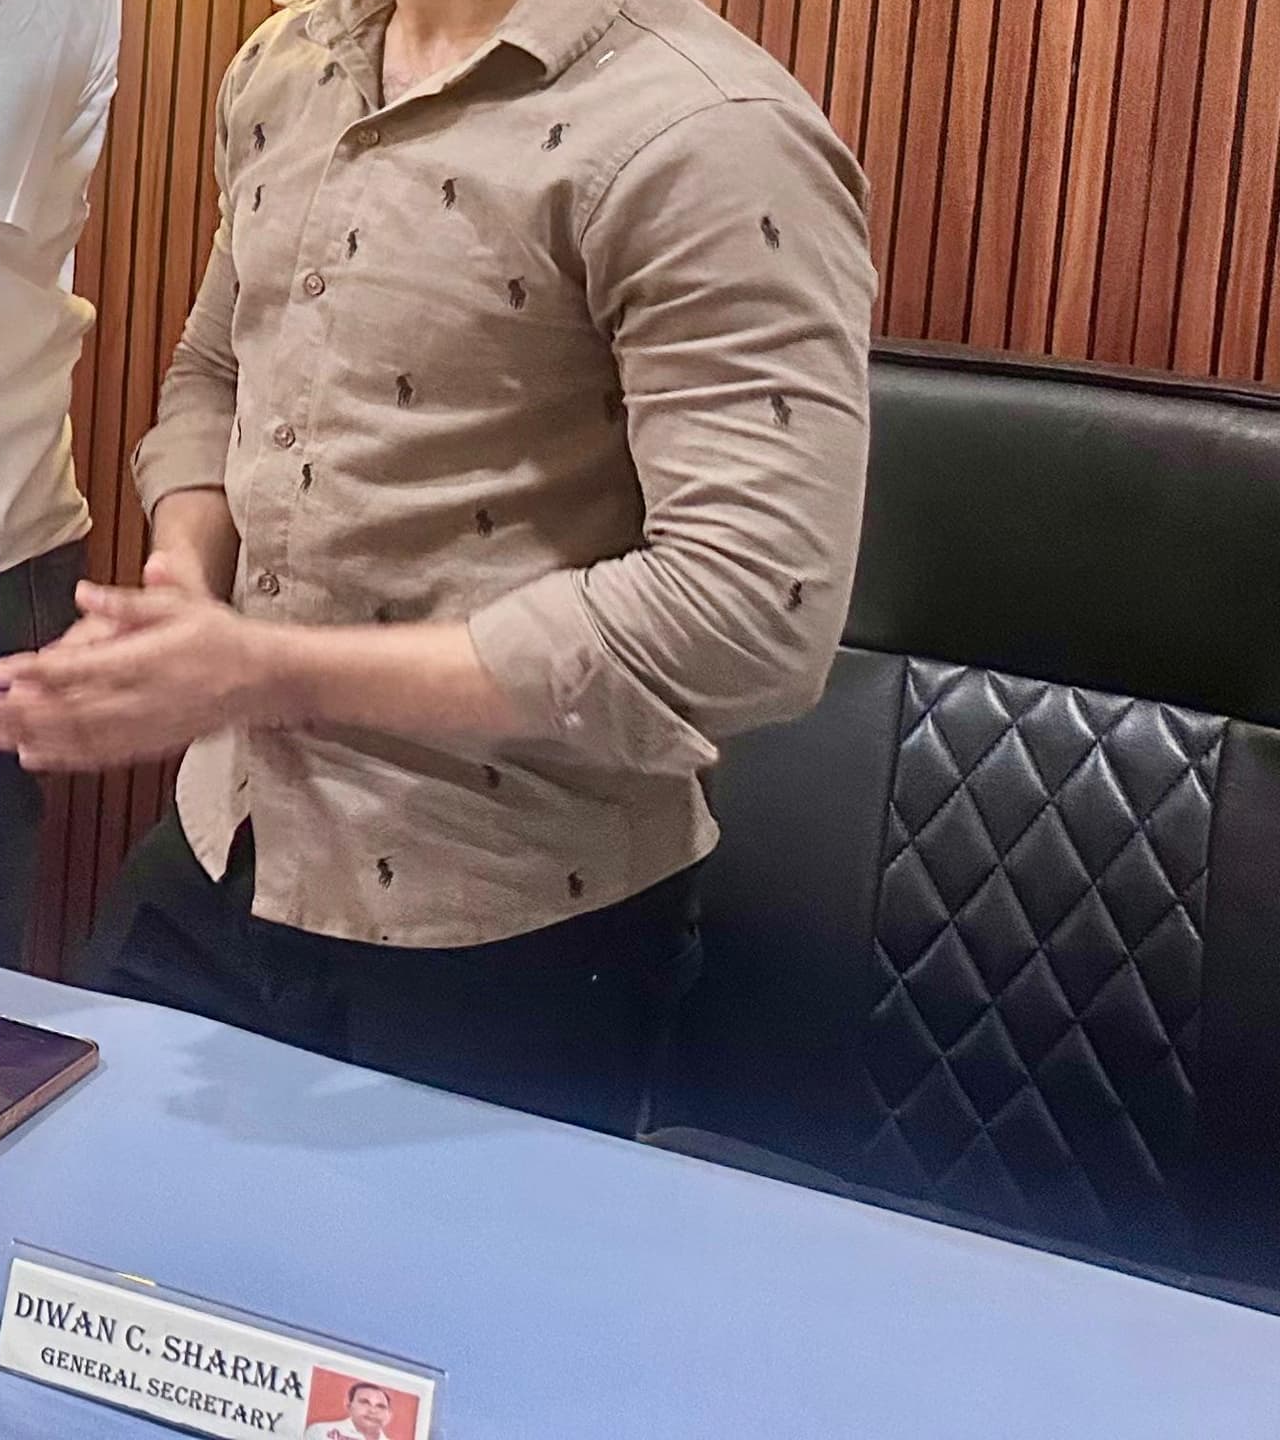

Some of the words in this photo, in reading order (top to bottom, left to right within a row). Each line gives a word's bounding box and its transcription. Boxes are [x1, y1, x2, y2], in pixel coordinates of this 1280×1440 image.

[14, 1291, 117, 1345] DIWAN
[125, 1323, 151, 1356] C.
[162, 1334, 304, 1401] SHARMA
[40, 1346, 141, 1393] GENERAL
[146, 1377, 283, 1433] SECRETARY
